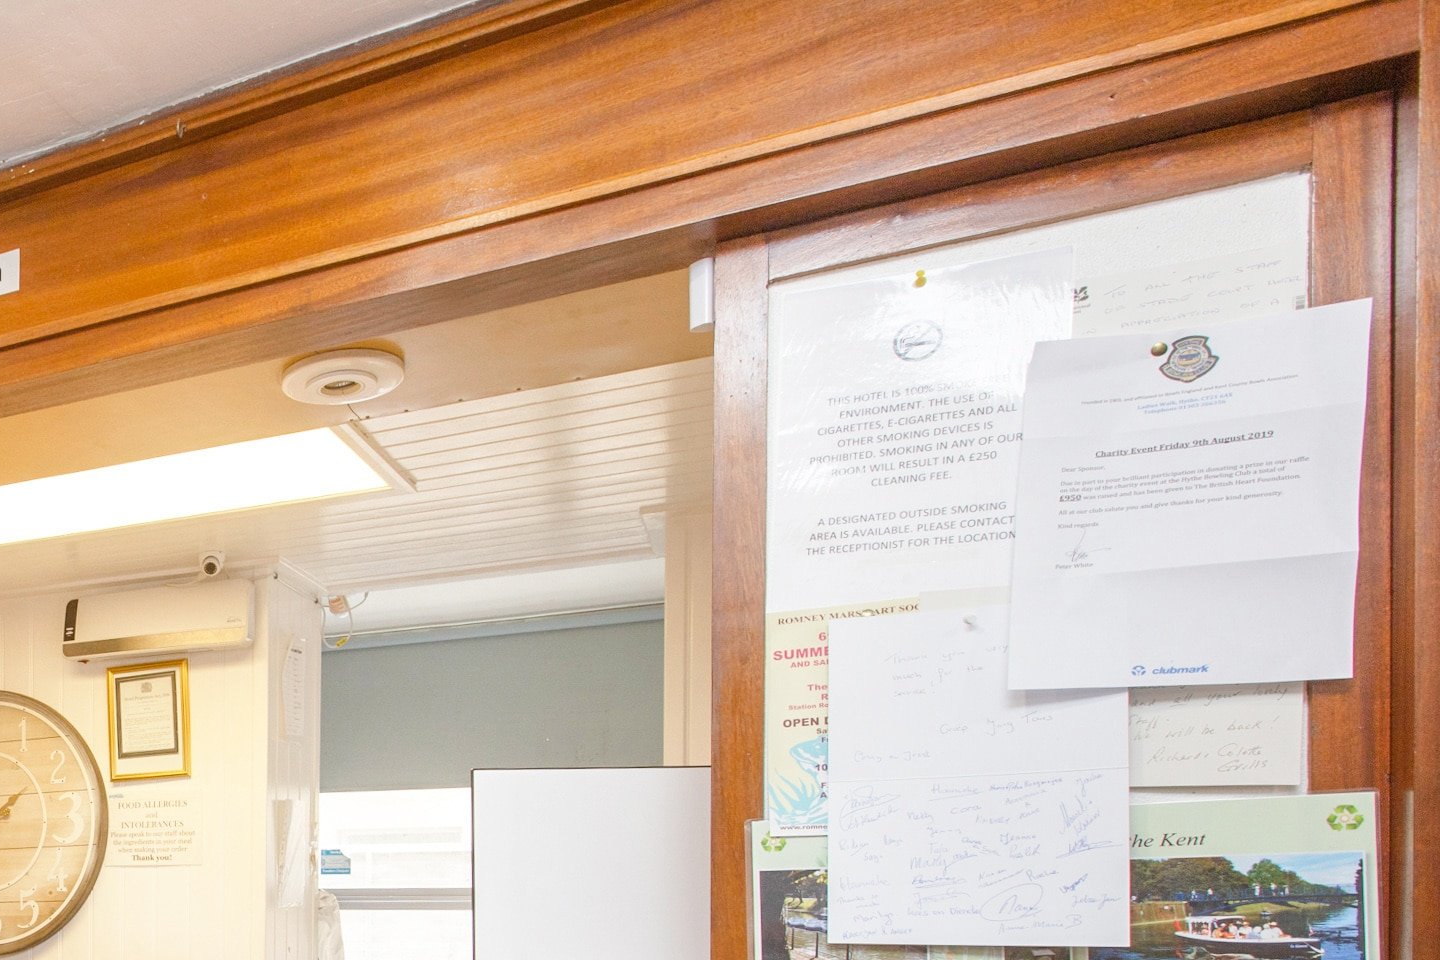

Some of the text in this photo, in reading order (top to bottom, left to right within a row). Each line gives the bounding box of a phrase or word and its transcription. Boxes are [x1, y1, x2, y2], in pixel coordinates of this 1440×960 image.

[828, 396, 850, 406] THIS
[854, 391, 888, 403] HOTEL
[892, 390, 901, 398] IS
[839, 398, 925, 418] ENVIRONMENT.
[926, 395, 952, 408] THE
[952, 392, 976, 405] USE
[817, 402, 1017, 437] CIGARETTES, E-CIGARETTES AND ALL
[837, 420, 994, 448] OTHER SMOKING DEVICES IS
[1095, 430, 1274, 458] Charity Event Friday 9th August 2019
[809, 432, 1023, 464] PROHIBITED. SMOKING IN ANY OF OUR
[830, 449, 997, 477] ROOM WILL RESULT IN A £250
[870, 468, 952, 486] CLEANING FEE.
[1059, 494, 1082, 503] £950
[817, 499, 1007, 526] A DESIGNATED OUTSIDE SMOKING
[809, 514, 1015, 541] AREA IS AVAILABLE. PLEASE CONTACT
[806, 528, 1017, 556] THE RECEPTIONIST FOR THE LOCATION
[778, 614, 825, 625] ROMNEY
[829, 610, 868, 619] MARS
[873, 606, 894, 616] ART
[1152, 664, 1209, 676] clubmark
[19, 718, 28, 752] 1
[783, 717, 819, 728] OPEN
[50, 750, 65, 784] 2
[143, 800, 188, 808] ALLERGIES
[52, 792, 85, 844] 3
[121, 820, 184, 829] INTOLERANCES
[1160, 833, 1206, 846] Kent
[17, 887, 39, 929] 5
